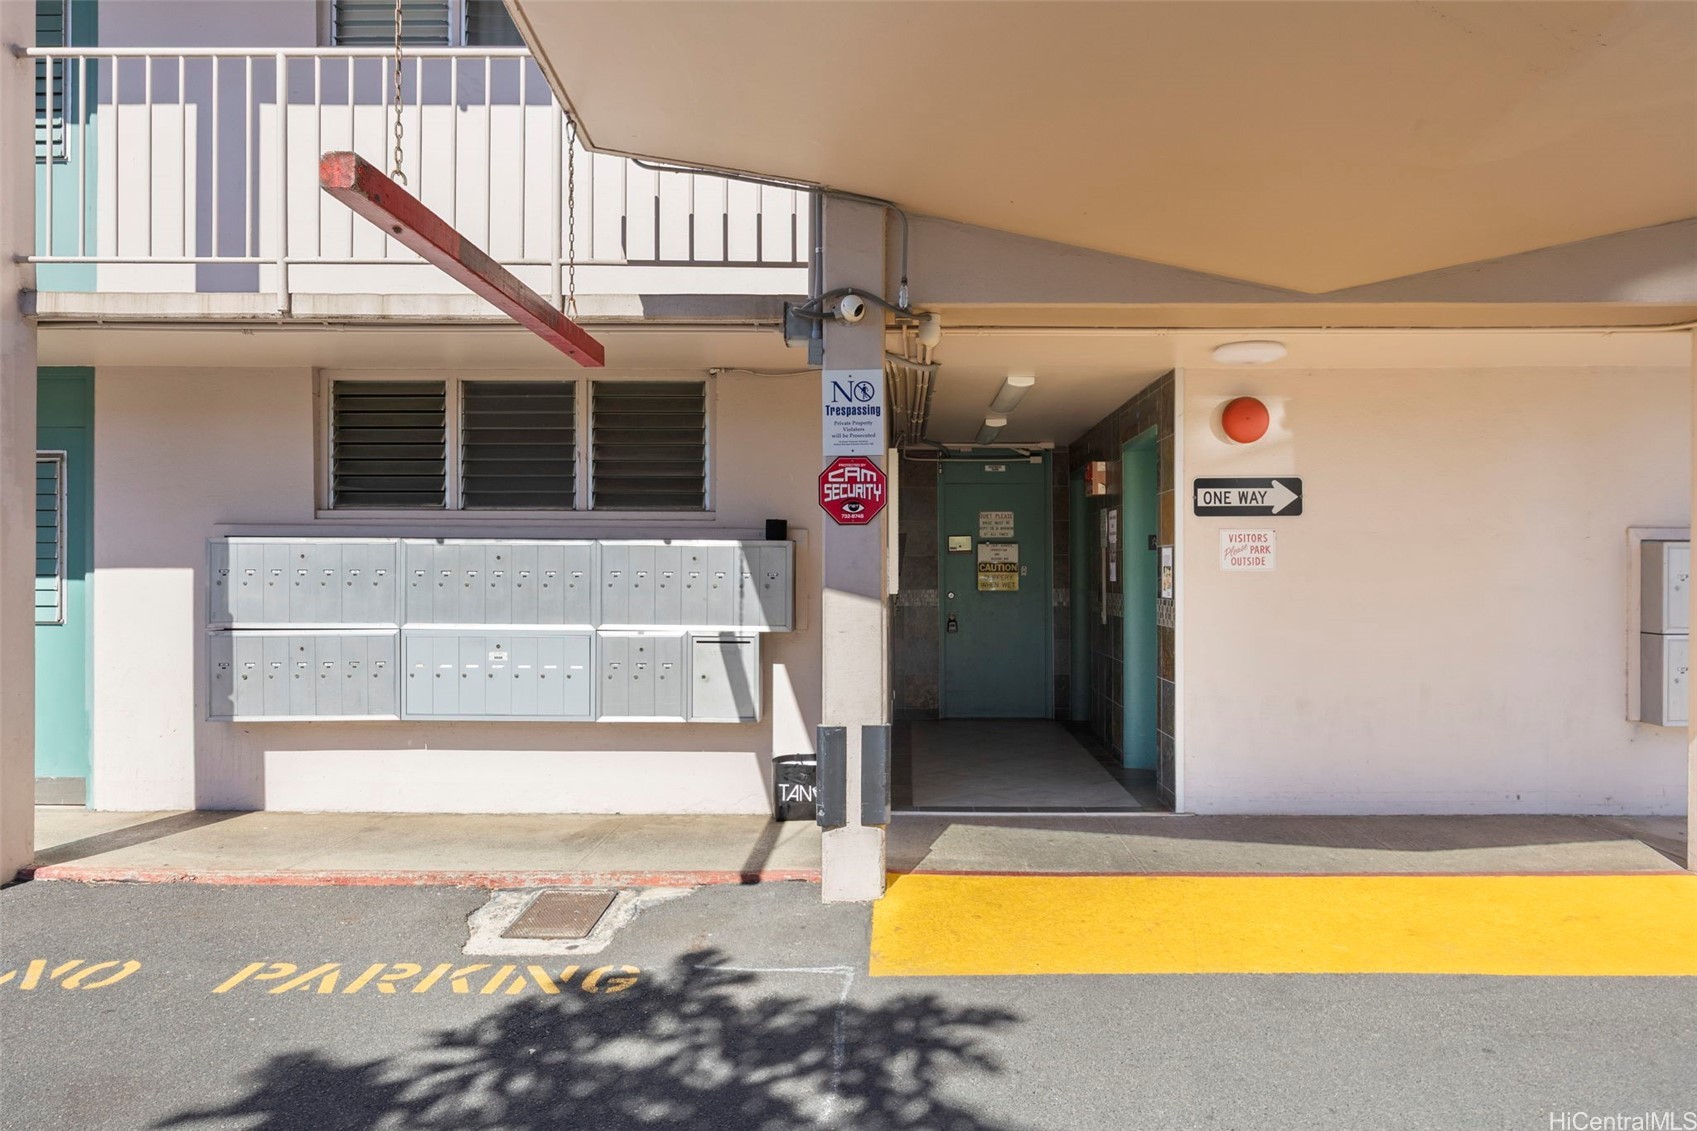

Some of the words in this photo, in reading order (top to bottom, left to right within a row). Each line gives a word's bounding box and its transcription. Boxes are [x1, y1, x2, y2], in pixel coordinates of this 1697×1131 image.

[825, 405, 881, 417] Trespassing
[828, 467, 876, 482] CAM
[824, 483, 882, 502] SECURITY
[1203, 491, 1232, 505] ONE
[1238, 491, 1268, 505] WAY
[1228, 533, 1268, 543] VISITORS
[1224, 544, 1248, 560] Please
[1250, 545, 1271, 555] PARK
[979, 563, 1017, 572] CAUTION
[1231, 557, 1266, 566] OUTSIDE
[211, 962, 641, 996] PARKING
